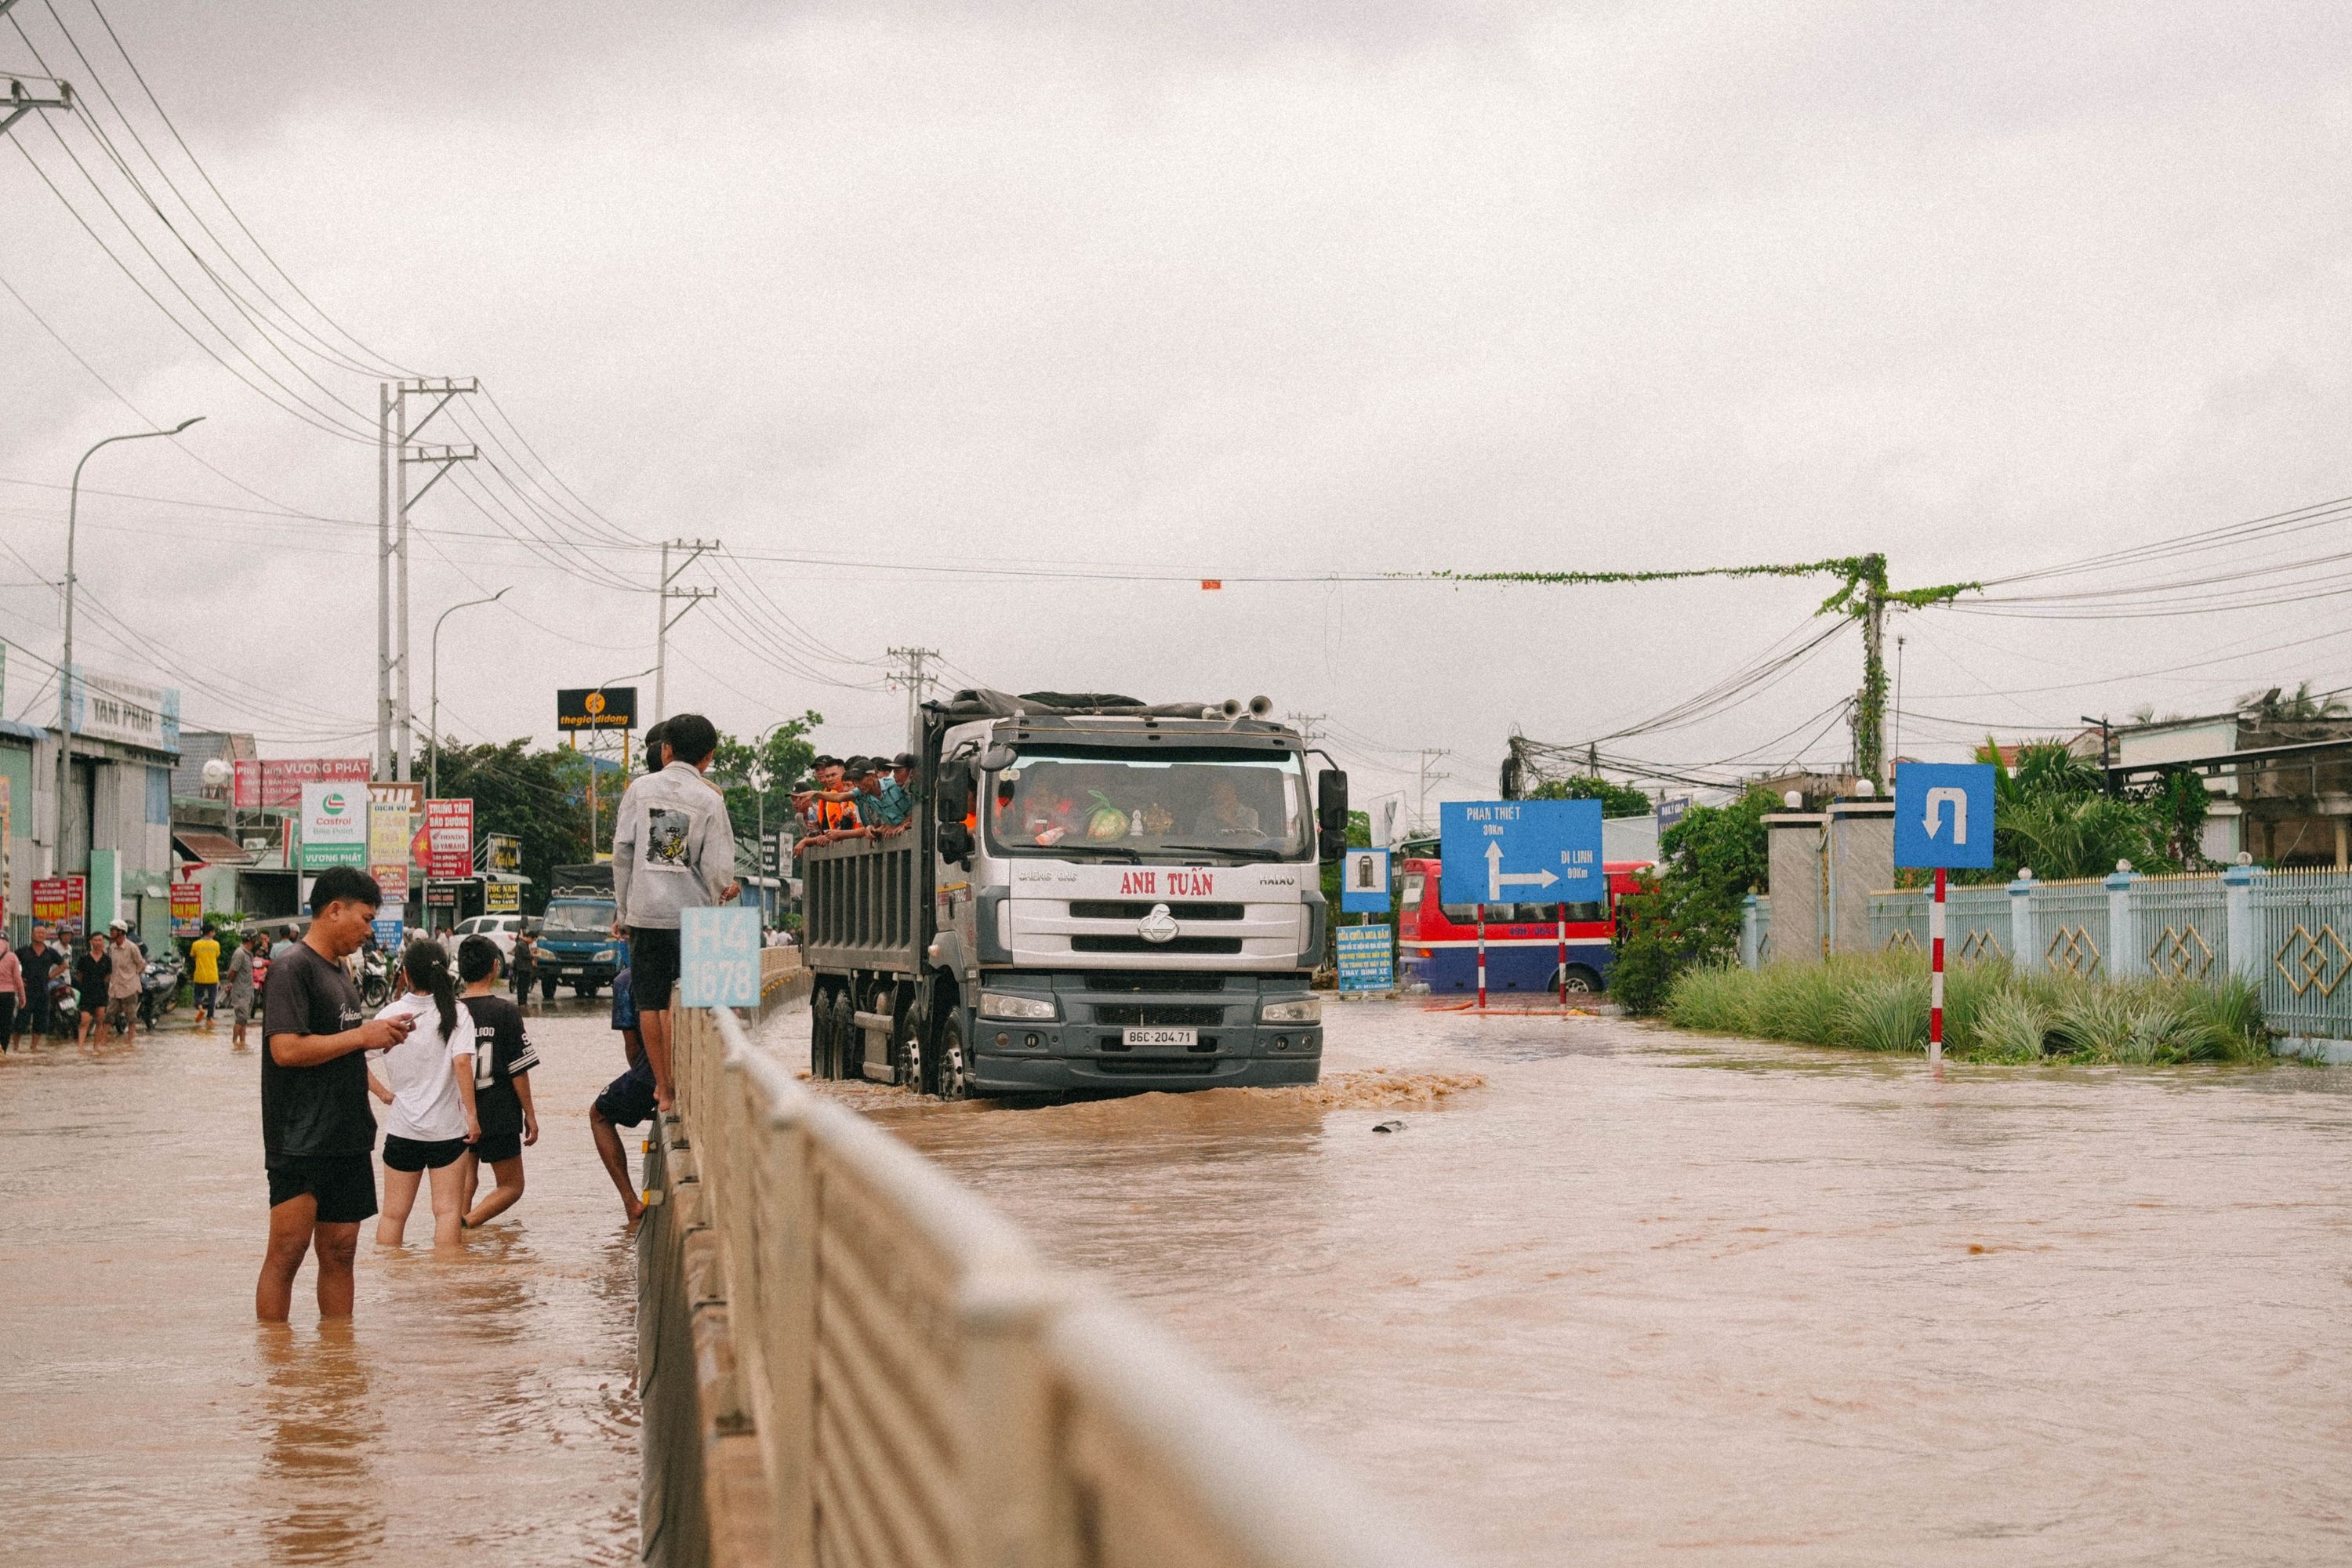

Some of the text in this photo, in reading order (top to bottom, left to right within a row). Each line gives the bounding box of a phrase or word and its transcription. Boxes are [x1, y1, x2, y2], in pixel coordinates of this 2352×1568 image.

[561, 714, 628, 726] thegiodidong
[335, 760, 368, 773] PHÁT
[429, 802, 470, 814] TRUNG TÂM
[1467, 804, 1521, 820] PHAN THIẾT
[1483, 825, 1504, 836] 30Km
[340, 853, 362, 862] PHÁT
[1561, 851, 1593, 863] DI LINH
[1567, 868, 1588, 879] 90Km
[1120, 866, 1213, 895] ANH TUẤN
[692, 908, 750, 955] H4
[691, 960, 752, 1001] 1678
